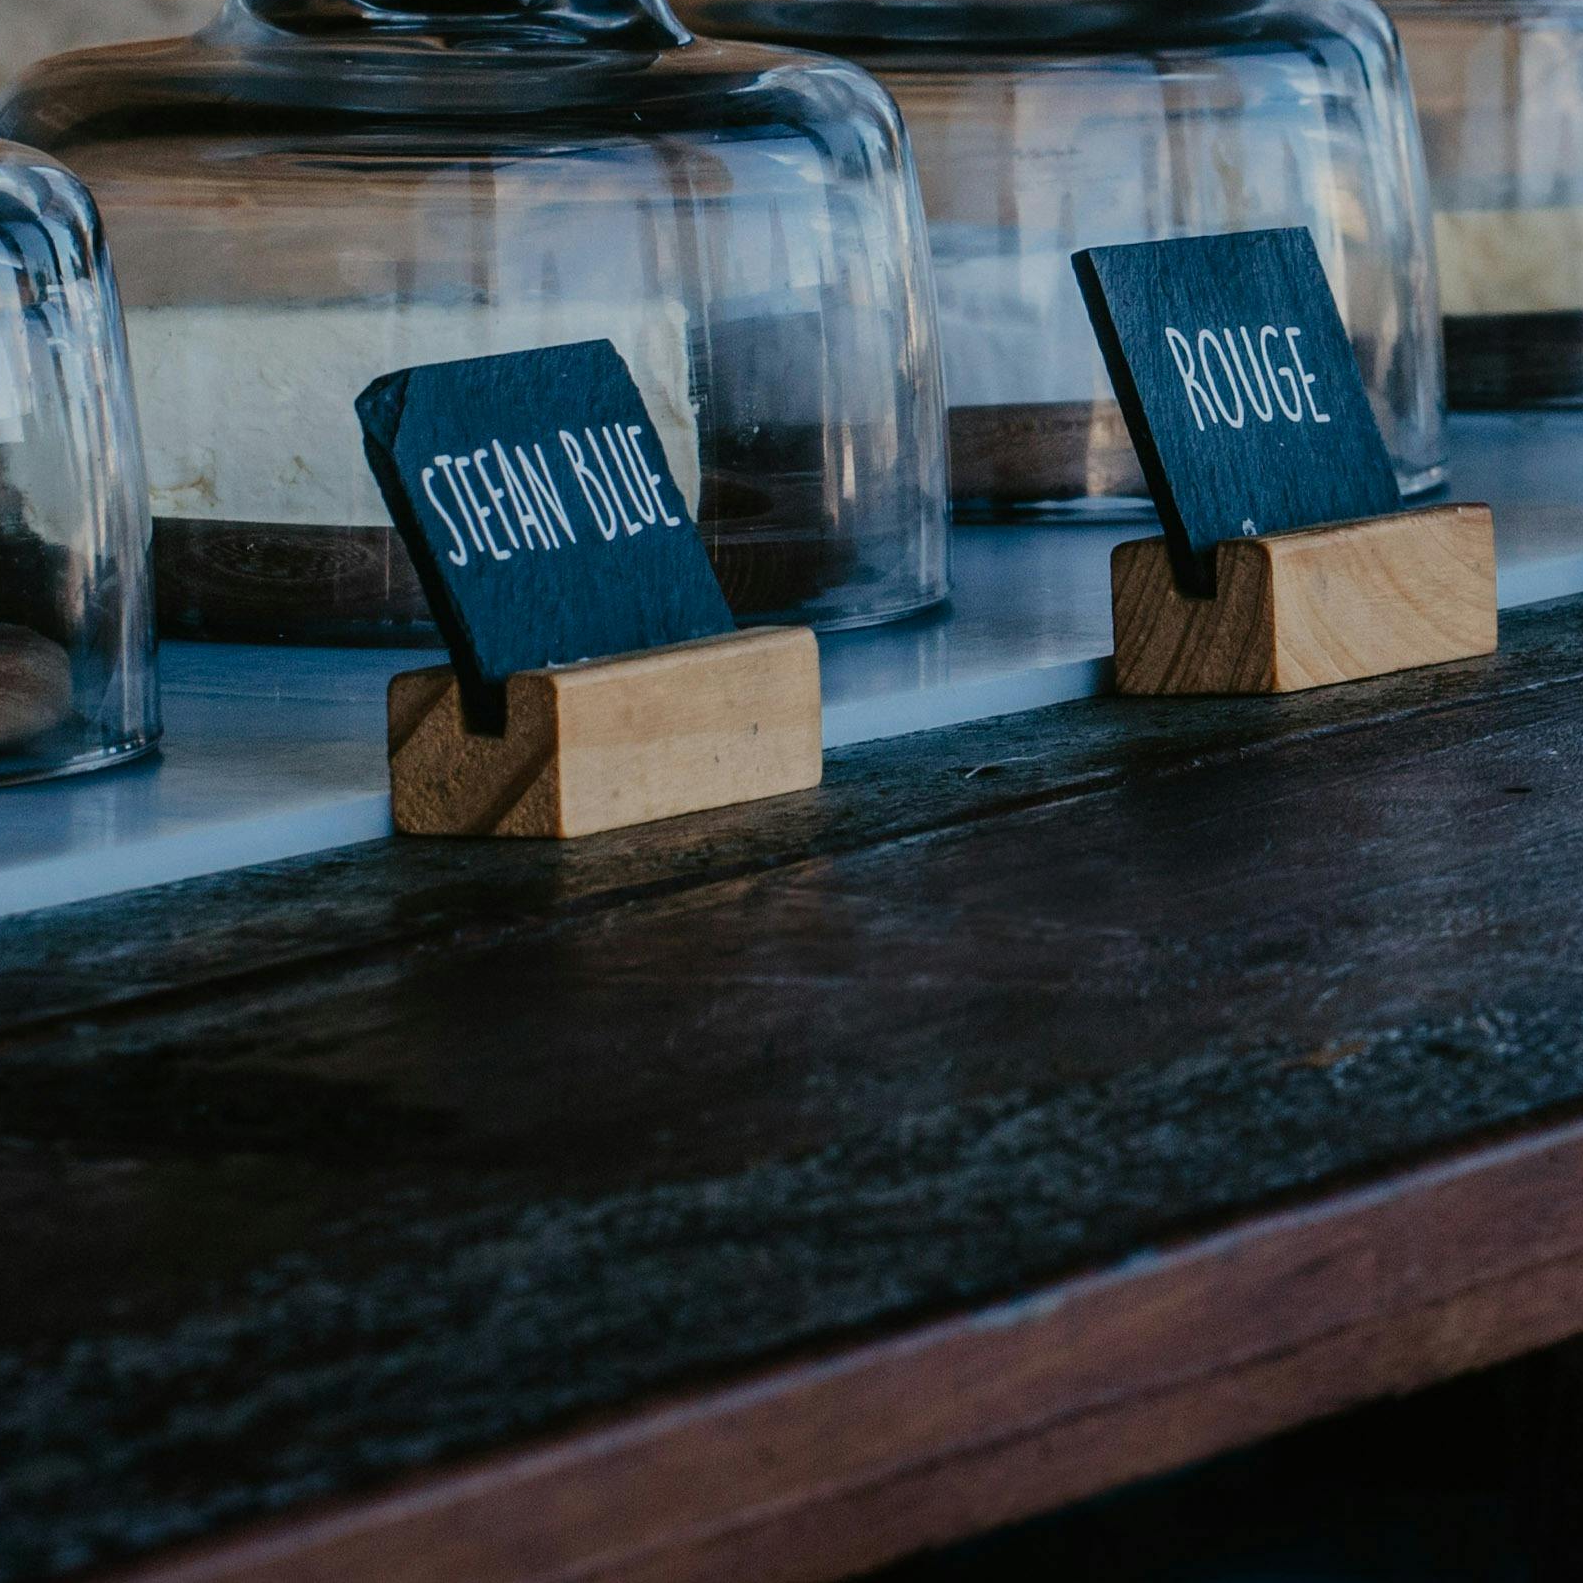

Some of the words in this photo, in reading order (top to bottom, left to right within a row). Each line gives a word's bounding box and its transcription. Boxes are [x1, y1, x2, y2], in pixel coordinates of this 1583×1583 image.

[1165, 325, 1331, 431] ROUGE
[421, 438, 577, 567] STEFAN
[558, 422, 680, 541] BLUE
